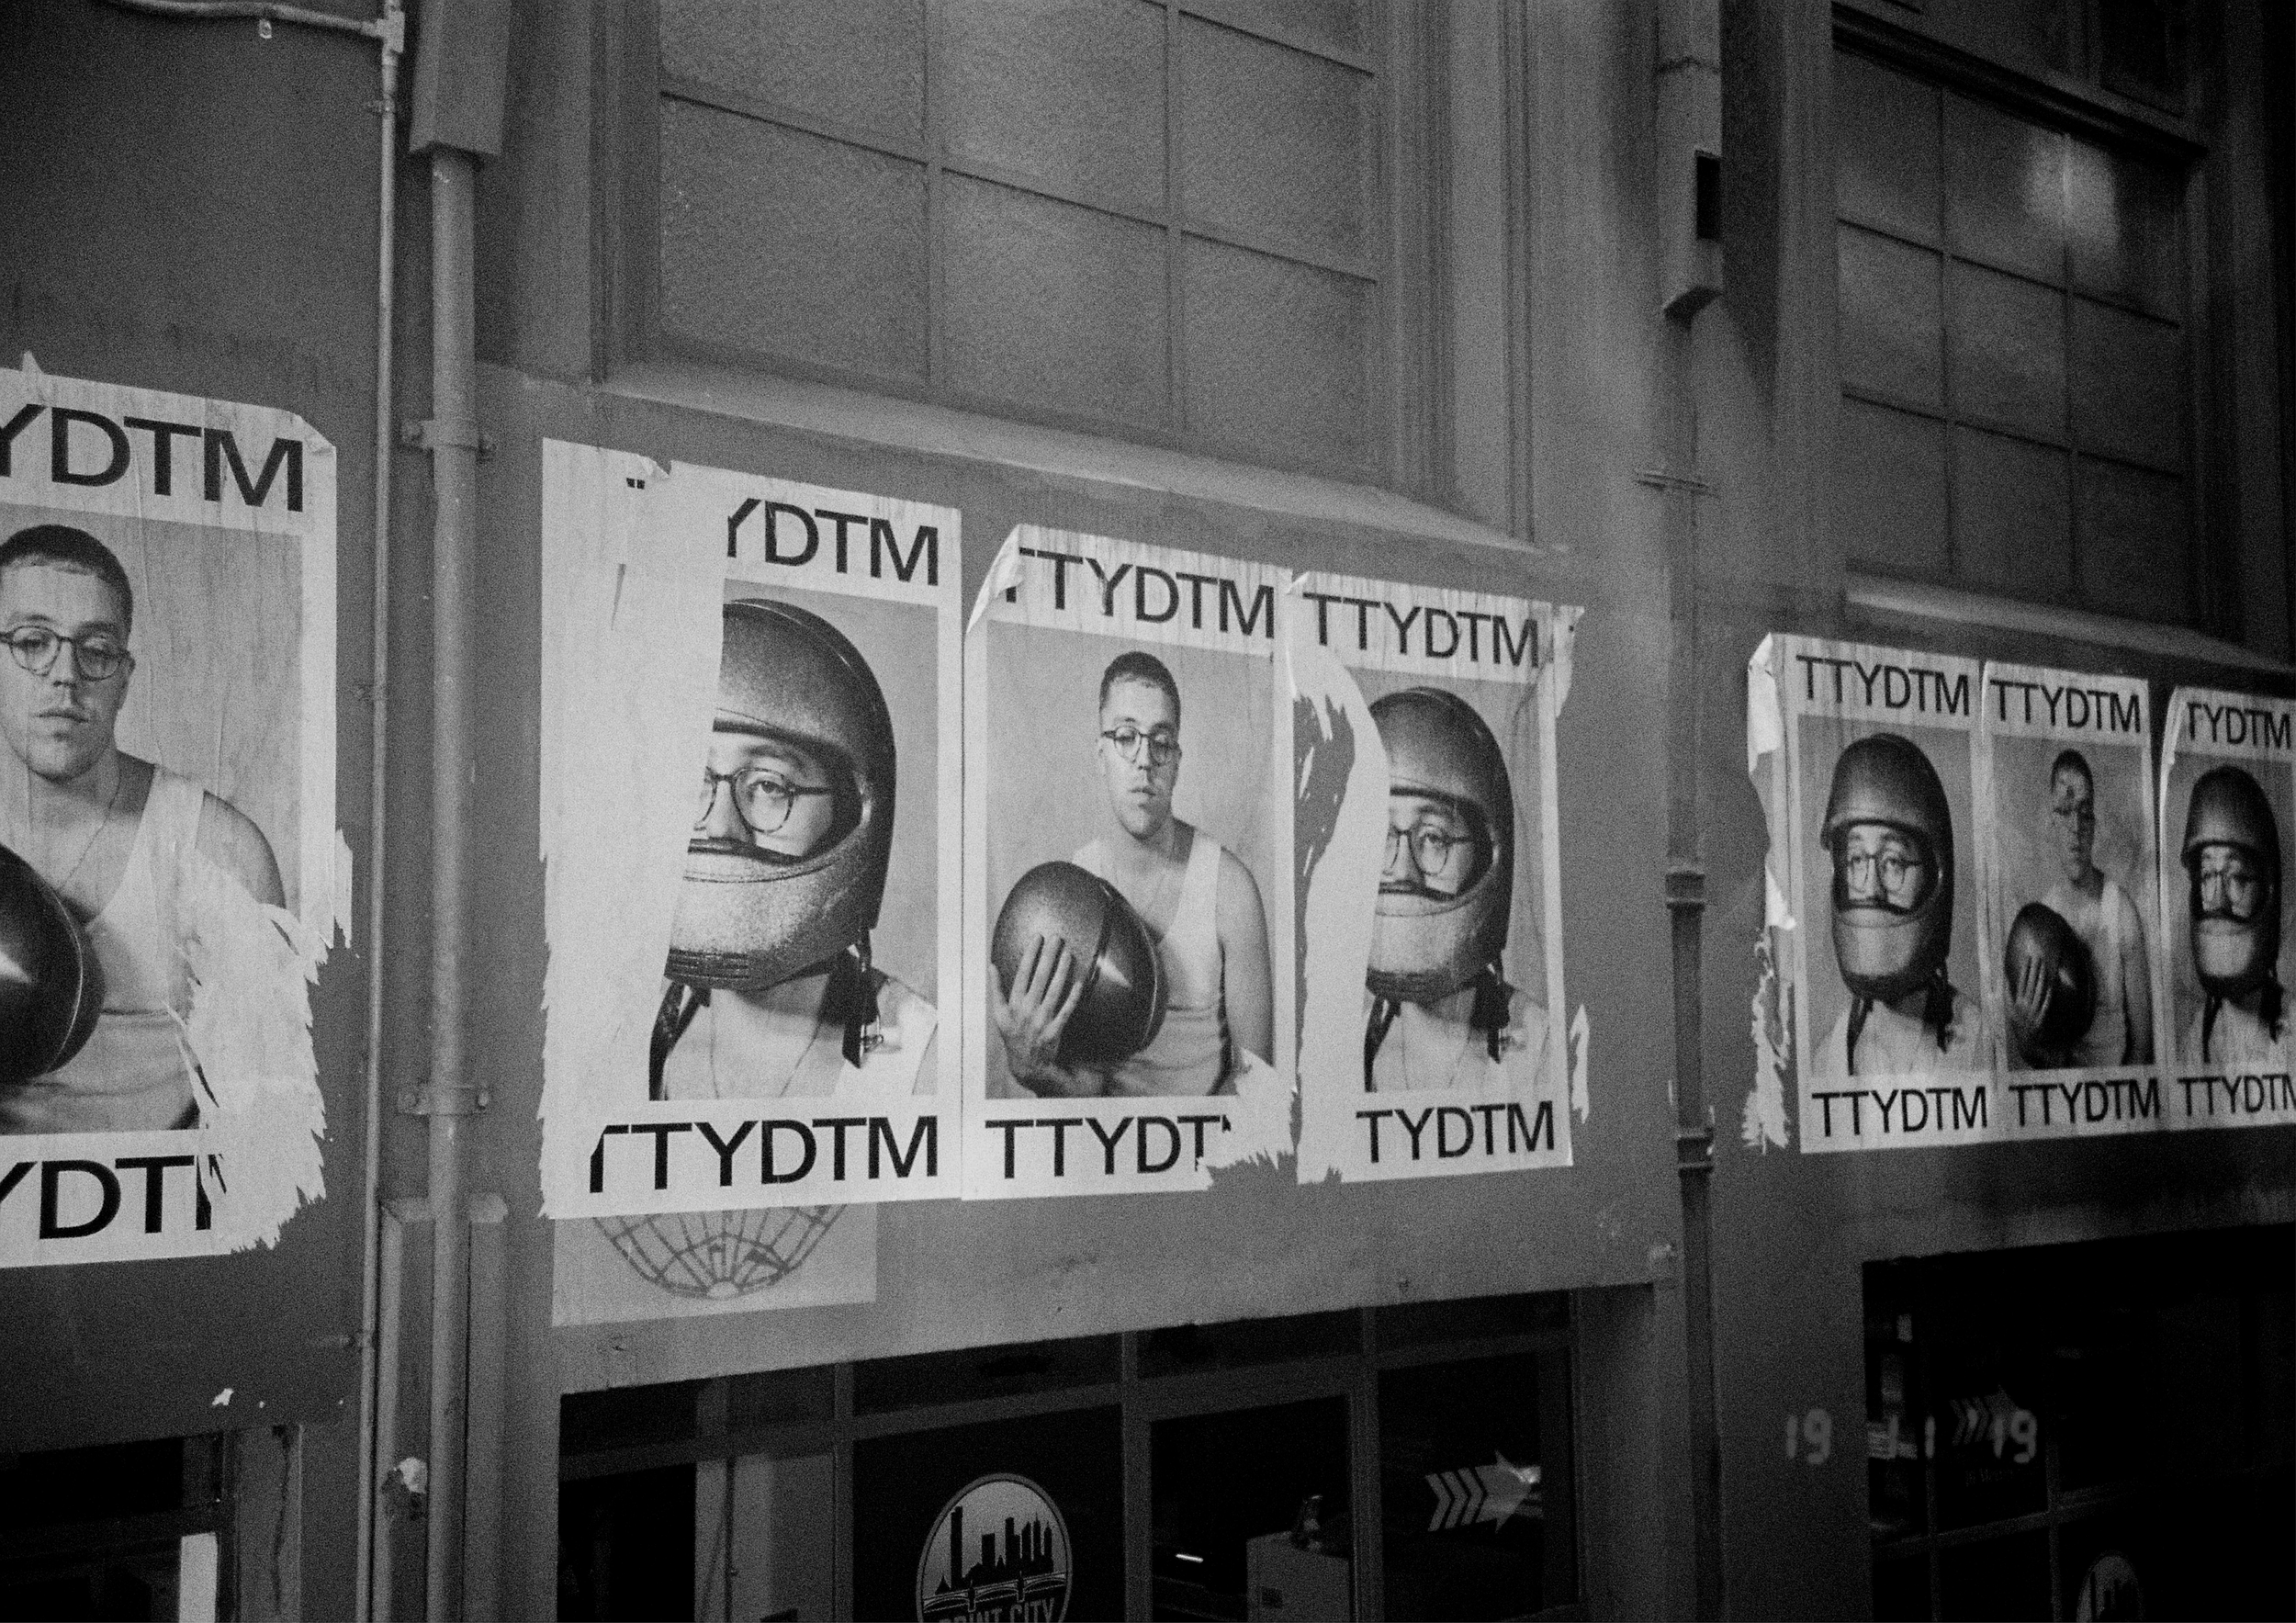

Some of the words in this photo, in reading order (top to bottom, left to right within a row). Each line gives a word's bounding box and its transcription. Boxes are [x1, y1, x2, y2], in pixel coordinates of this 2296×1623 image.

[1302, 591, 1539, 670] TTYDTM
[1796, 654, 1970, 717] TTYDTM
[1989, 679, 2141, 734] TTYDTM
[1356, 1099, 1555, 1164] TYDTM
[1812, 1086, 1988, 1137] TTYDTM
[2009, 1077, 2160, 1127] TTYDTM
[985, 1113, 1232, 1179] TTYDT
